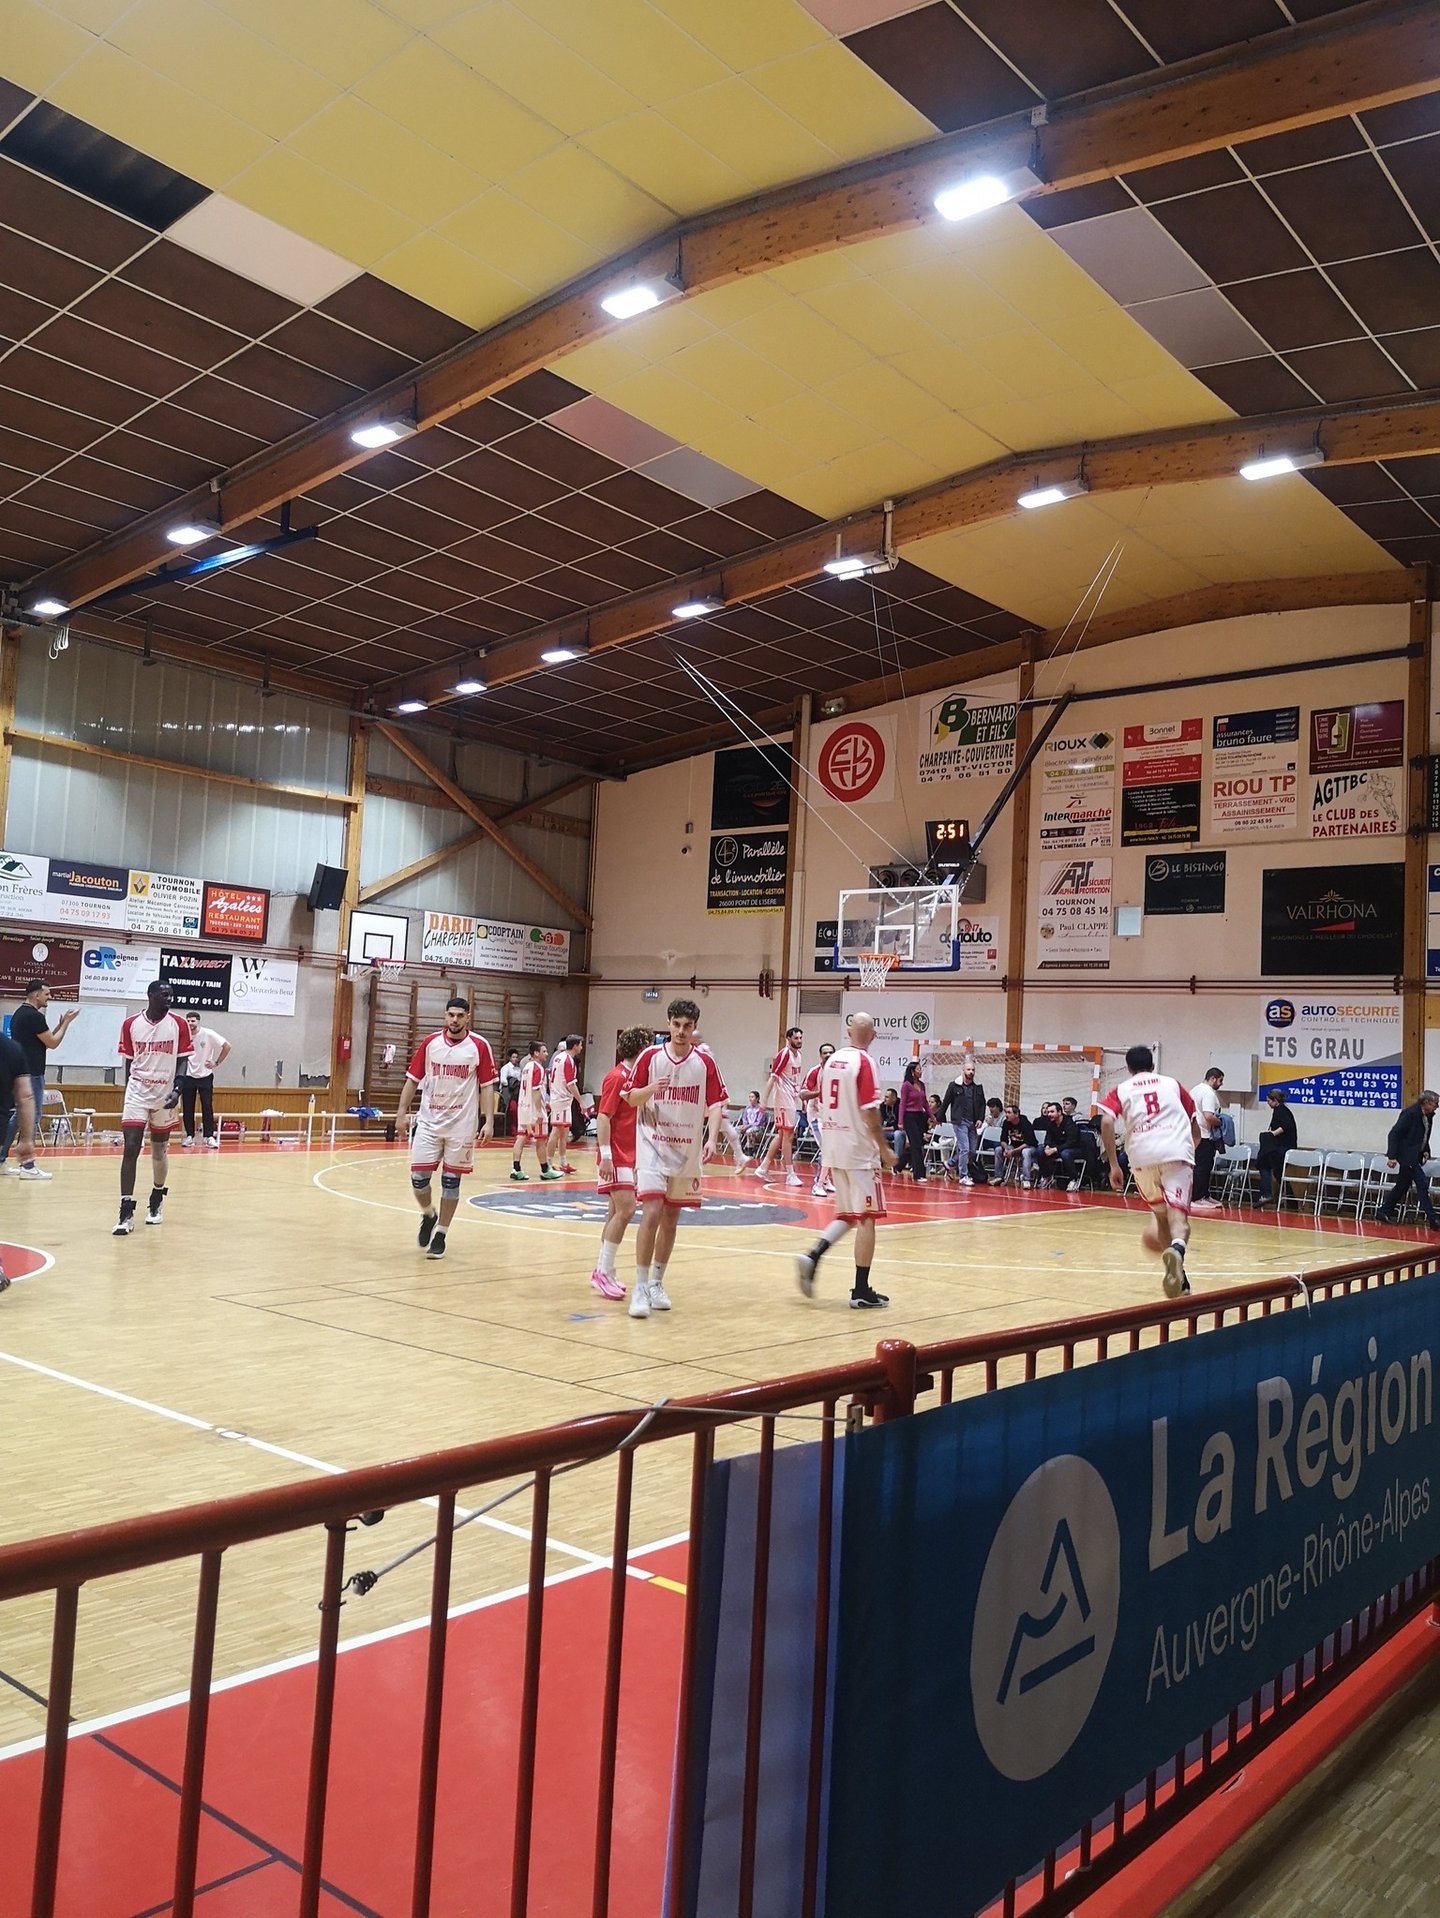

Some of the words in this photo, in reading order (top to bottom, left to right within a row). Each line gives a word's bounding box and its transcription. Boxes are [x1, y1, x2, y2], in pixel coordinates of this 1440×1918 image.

[970, 705, 1016, 726] BERNARD
[976, 726, 987, 743] ET
[989, 723, 1008, 741] FILS
[1149, 725, 1176, 735] Bonnet
[1216, 729, 1254, 738] assurances
[1045, 738, 1087, 752] RIOUX
[1216, 737, 1245, 747] bruno
[1247, 734, 1272, 744] faure
[920, 750, 961, 768] CHARPENTE
[966, 743, 1015, 763] COUVERTURE
[920, 768, 947, 776] 07410
[954, 760, 1013, 772] ST-VICTOR
[1214, 778, 1263, 797] RIOU
[1269, 775, 1296, 792] TP
[1313, 773, 1368, 811] AGTTBC
[1214, 799, 1273, 809] TERRASSEMENT
[1279, 796, 1296, 804] VRD
[1044, 808, 1112, 823] Intermarché
[1222, 806, 1286, 817] ASSAINISSEMENT
[1313, 813, 1322, 822] LE
[1326, 808, 1356, 821] CLUB
[1360, 809, 1379, 819] DES
[937, 824, 964, 840] 2:51
[1313, 821, 1397, 837] PARTENAIRES
[743, 841, 786, 859] Parallèle
[52, 871, 71, 879] martial
[69, 871, 119, 887] Jacouton
[158, 876, 195, 887] TOURNON
[711, 869, 722, 885] de
[725, 866, 786, 884] l'immobilier
[151, 883, 200, 895] AUTOMOBILE
[1089, 878, 1111, 887] SÉCURITÉ
[12, 883, 43, 896] Frères
[211, 889, 240, 900] HÔTEL
[153, 892, 177, 901] OLIVIER
[180, 895, 198, 903] POZIN
[1056, 898, 1096, 906] TOURNON
[81, 901, 111, 910] TOURNON
[209, 896, 262, 914] Azalées
[1042, 908, 1053, 916] 04
[1056, 907, 1067, 916] 75
[1070, 907, 1081, 916] 08
[1085, 907, 1096, 915] 45
[1099, 906, 1109, 914] 14
[1287, 903, 1378, 920] VALRHONA
[208, 912, 261, 924] RESTAURANT
[173, 927, 181, 935] 61
[185, 928, 194, 936] 61
[488, 926, 524, 939] COOPTAIN
[1059, 923, 1075, 931] Paul
[1077, 923, 1108, 931] CLAPPE
[424, 929, 475, 949] CHARPENTE
[104, 954, 139, 962] enseignes
[161, 954, 195, 969] TAXI
[193, 959, 231, 969] DIRECT
[425, 954, 471, 965] 04.75.06.76.13
[240, 957, 268, 980] W
[168, 978, 201, 987] TOURNON
[202, 997, 211, 1005] 01
[214, 998, 223, 1006] 01
[1269, 1005, 1292, 1019] as
[883, 1015, 908, 1028] vert
[1265, 1036, 1297, 1058] ETS
[1311, 1037, 1365, 1060] GRAU
[880, 1056, 891, 1066] 64
[898, 1057, 908, 1067] 12
[443, 1064, 469, 1079] TOURNON
[1340, 1071, 1398, 1080] TOURNON
[1384, 1081, 1397, 1089] 79
[668, 1085, 700, 1105] TOURNON
[829, 1079, 840, 1110] 9
[1289, 1088, 1314, 1096] TAIN
[1320, 1089, 1397, 1099] L'HERMITAGE
[1144, 1091, 1160, 1115] 8
[866, 1196, 872, 1207] 9
[1149, 1416, 1235, 1572] La
[1254, 1336, 1432, 1514] Région
[1145, 1476, 1431, 1704] Auvergne-Rhône-Alpes
